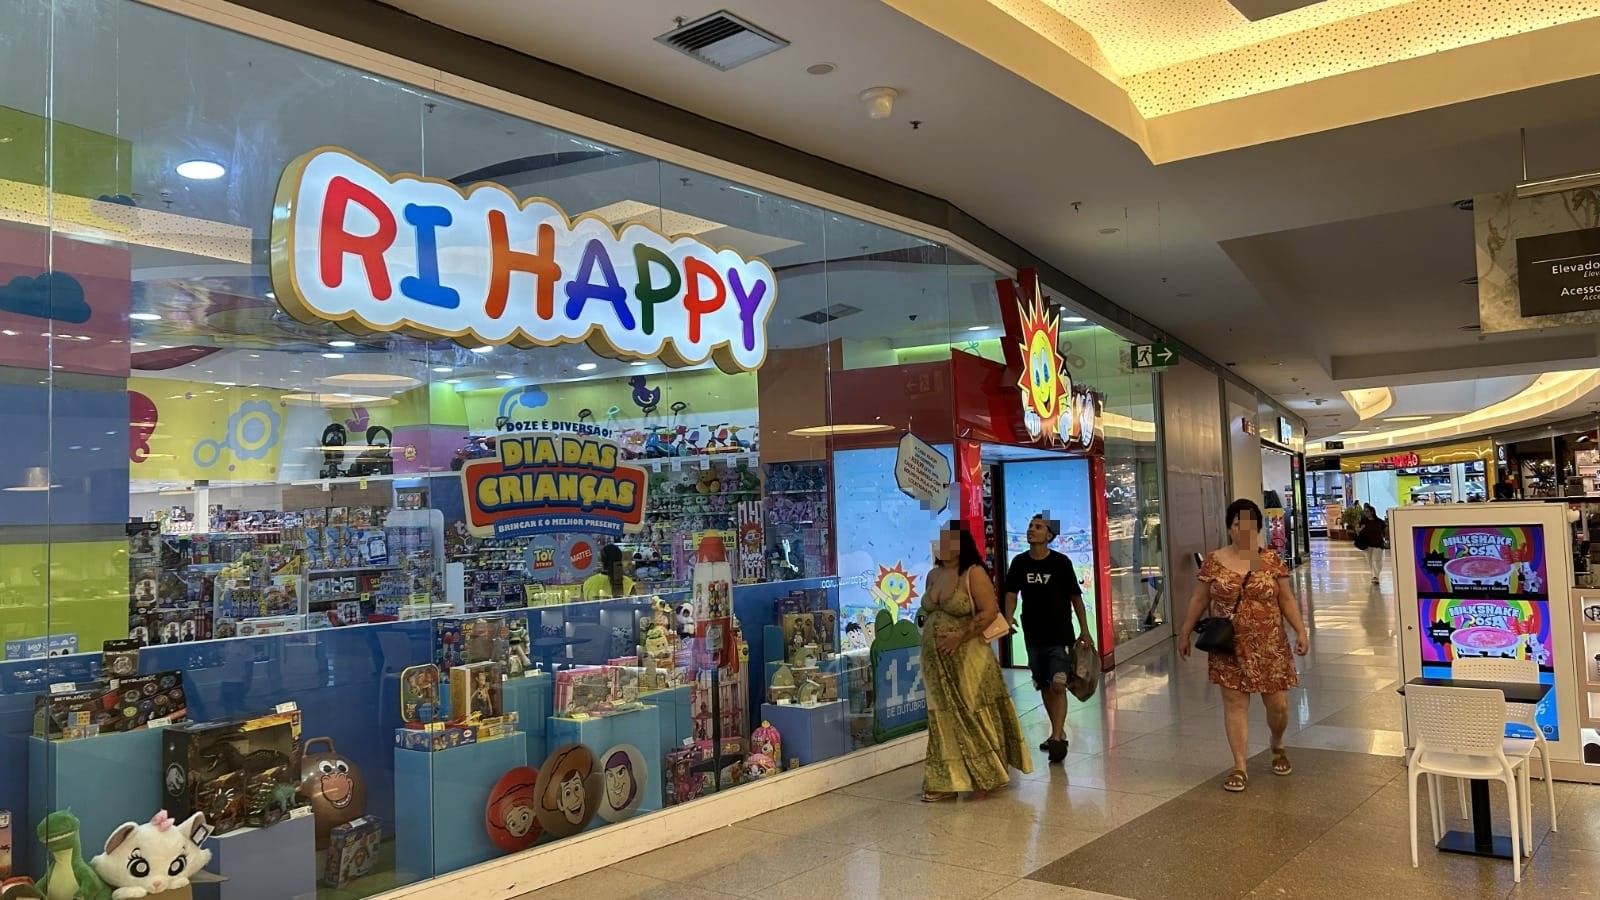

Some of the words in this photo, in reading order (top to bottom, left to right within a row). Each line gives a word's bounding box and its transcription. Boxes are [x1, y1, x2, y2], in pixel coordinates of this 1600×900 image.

[320, 175, 460, 309] RI
[484, 208, 767, 351] HAPPY
[507, 421, 538, 432] DOZE
[542, 419, 549, 430] É
[551, 421, 612, 438] DIVERSÃO!
[502, 438, 557, 469] DIA
[562, 439, 617, 471] DAS
[478, 473, 635, 512] CRIANÇAS
[498, 520, 537, 533] BRINCAR
[552, 518, 584, 526] MELHOR
[585, 519, 620, 530] PRESENTE
[1442, 534, 1513, 547] MILKSHAKE
[533, 549, 554, 561] TOY
[570, 549, 593, 562] MATTEL
[1026, 573, 1051, 584] EA7
[1448, 605, 1520, 617] MILKSHAKE
[886, 656, 926, 707] 12
[896, 700, 926, 716] OUTUBRO
